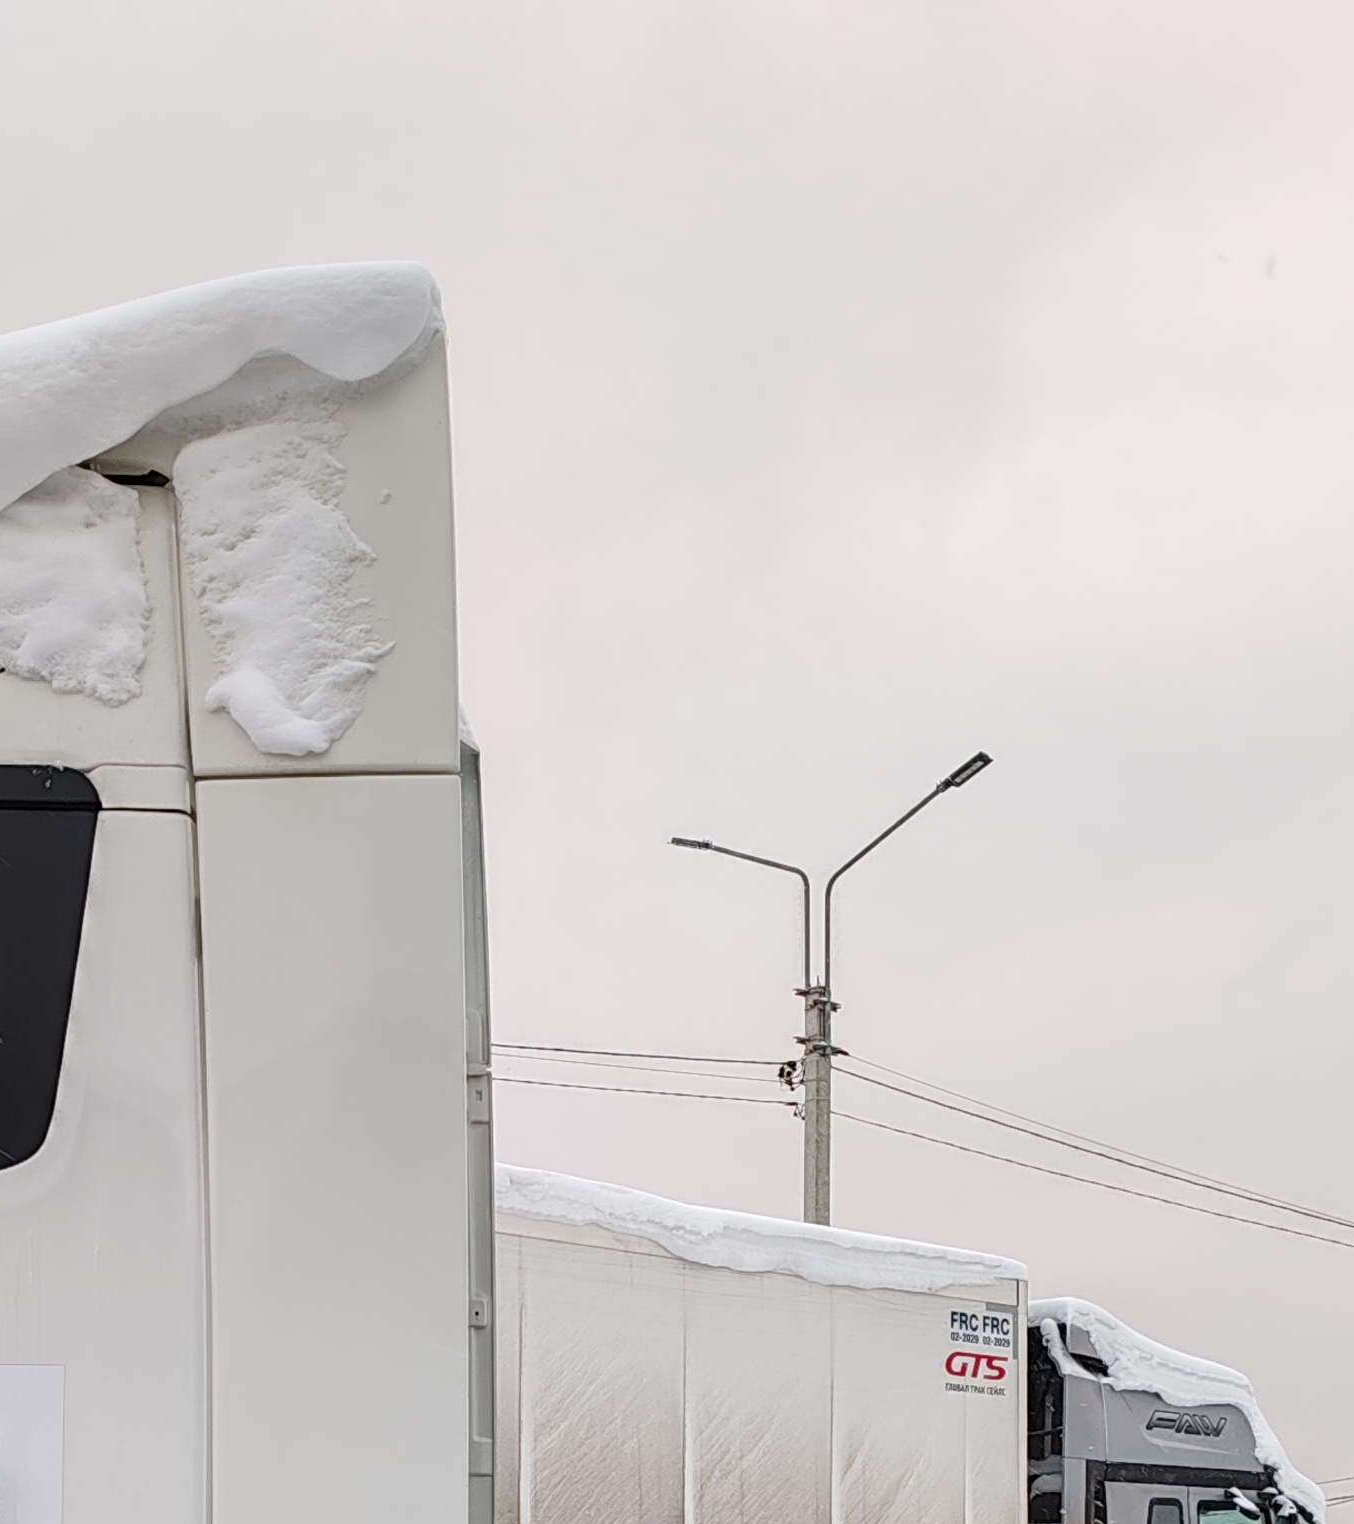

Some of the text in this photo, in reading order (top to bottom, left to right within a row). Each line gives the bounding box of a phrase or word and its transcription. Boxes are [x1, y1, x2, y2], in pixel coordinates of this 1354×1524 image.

[950, 1311, 1010, 1336] FRC FRC
[950, 1332, 1010, 1347] 02-2029 02-2029
[945, 1351, 1008, 1380] GTS
[1146, 1410, 1227, 1437] FAW
